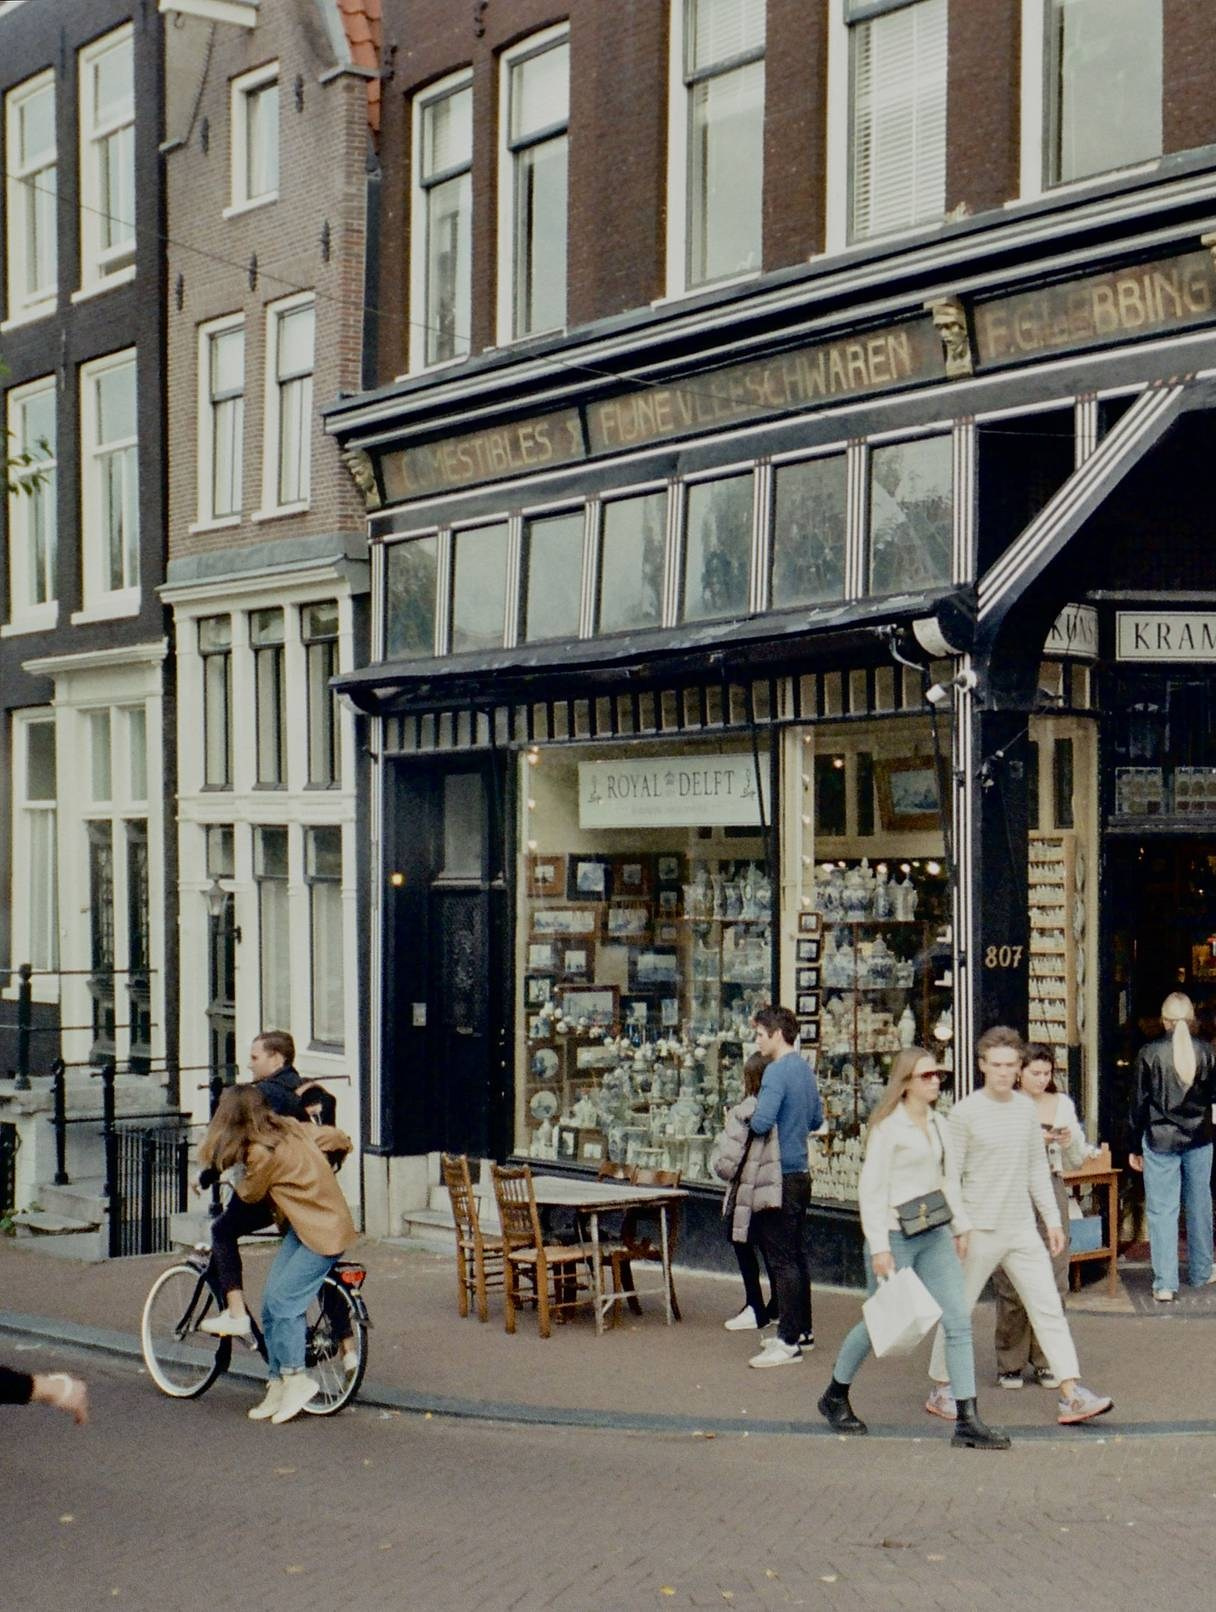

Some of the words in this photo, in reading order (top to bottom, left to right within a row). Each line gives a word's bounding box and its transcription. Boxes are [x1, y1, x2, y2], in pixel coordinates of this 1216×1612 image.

[600, 390, 675, 445] FIJNE
[1050, 613, 1095, 645] KUNS
[607, 774, 660, 799] ROYAL
[678, 769, 736, 797] DELFT
[984, 945, 1024, 969] 807
